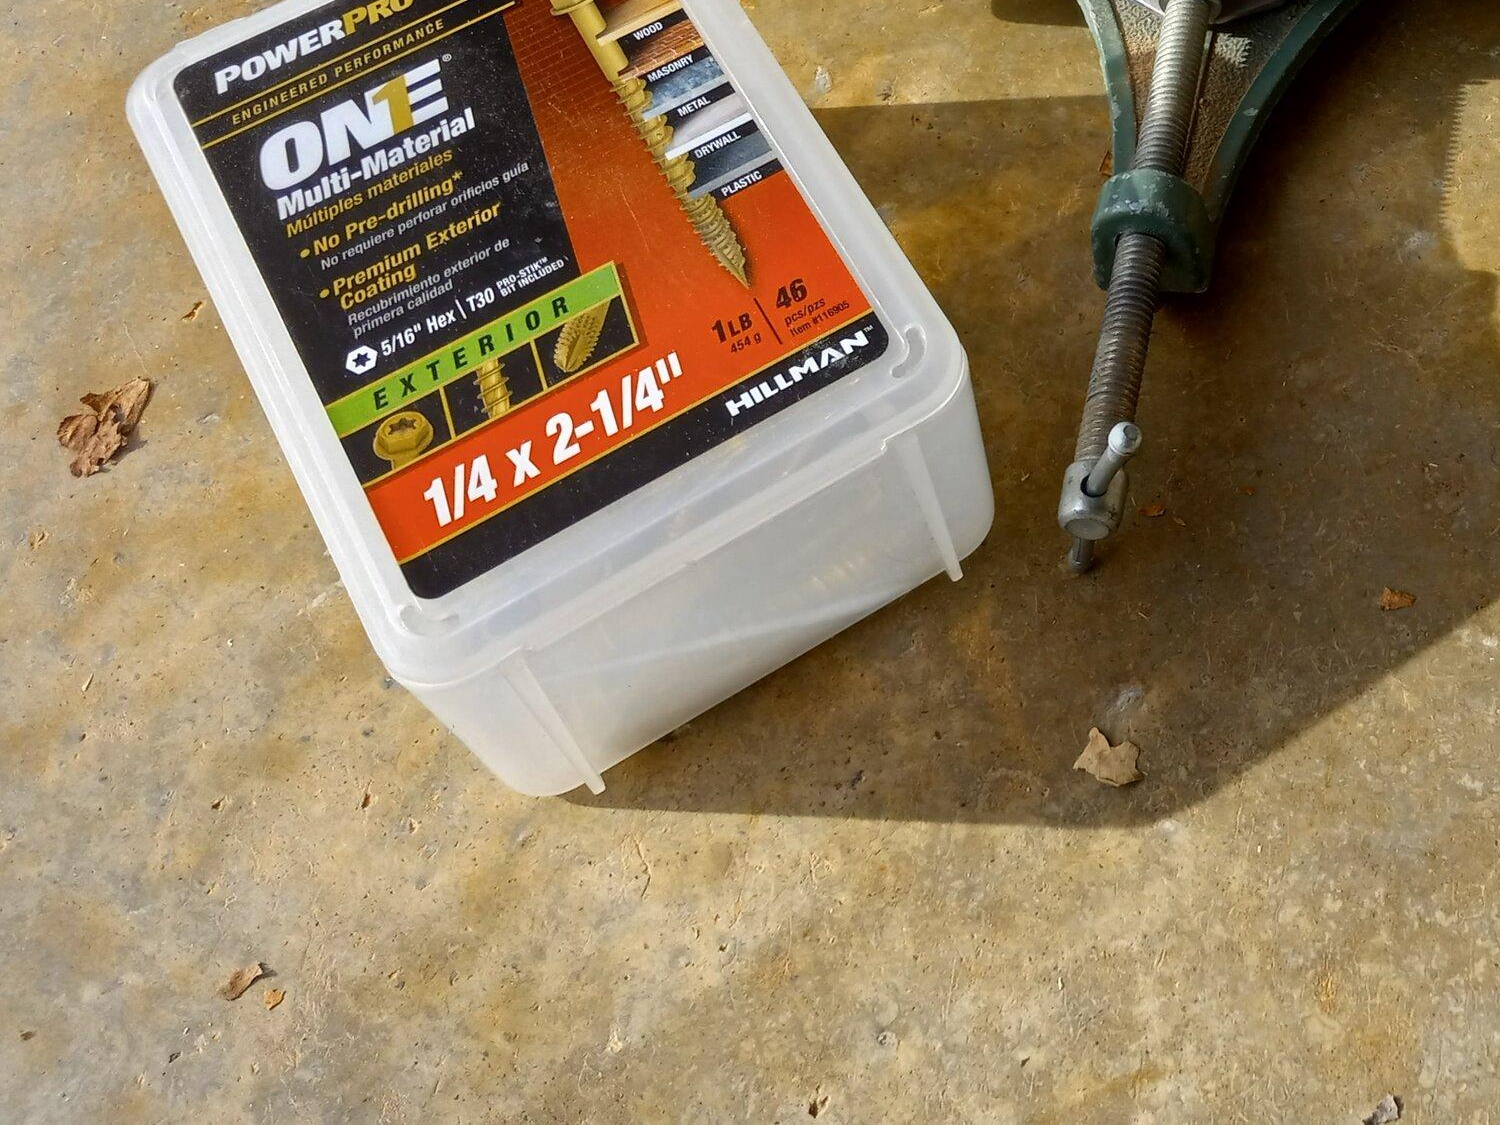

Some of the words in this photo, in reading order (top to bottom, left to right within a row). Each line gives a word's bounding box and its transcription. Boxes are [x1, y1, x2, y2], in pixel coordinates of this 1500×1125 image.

[633, 21, 664, 41] WOOD
[232, 75, 328, 125] ENGINEERED
[335, 18, 445, 78] PERFORMANCE
[647, 54, 694, 83] MASONRY
[677, 96, 711, 117] METAL
[276, 107, 475, 221] Multi-Material
[694, 131, 742, 159] DRYWALL
[286, 192, 364, 239] Múltiples
[368, 149, 454, 201] materiales
[721, 171, 762, 197] PLASTIC
[321, 255, 338, 271] No
[342, 228, 395, 261] requiere
[398, 201, 448, 235] perforar
[450, 176, 500, 207] orificios
[502, 161, 530, 185] guía
[313, 233, 340, 255] No
[332, 243, 422, 296] Premium
[426, 201, 502, 251] Exterior
[340, 263, 418, 311] Coating
[348, 273, 441, 325] Recubrimiento
[443, 247, 492, 278] exterior
[494, 237, 510, 252] de
[500, 283, 517, 297] BIT
[518, 259, 565, 289] INCLUDED
[776, 278, 808, 309] 46
[352, 307, 404, 339] primera
[406, 279, 454, 311] calidad
[380, 323, 422, 357] 5/16"
[426, 308, 457, 334] Hex
[466, 288, 496, 313] T30
[784, 298, 826, 326] pcs/pzs
[790, 321, 812, 337] Item
[374, 296, 570, 411] EXTERIOR
[730, 337, 751, 354] 454
[754, 333, 762, 344] g
[423, 454, 498, 527] 1/4
[505, 440, 541, 487] x
